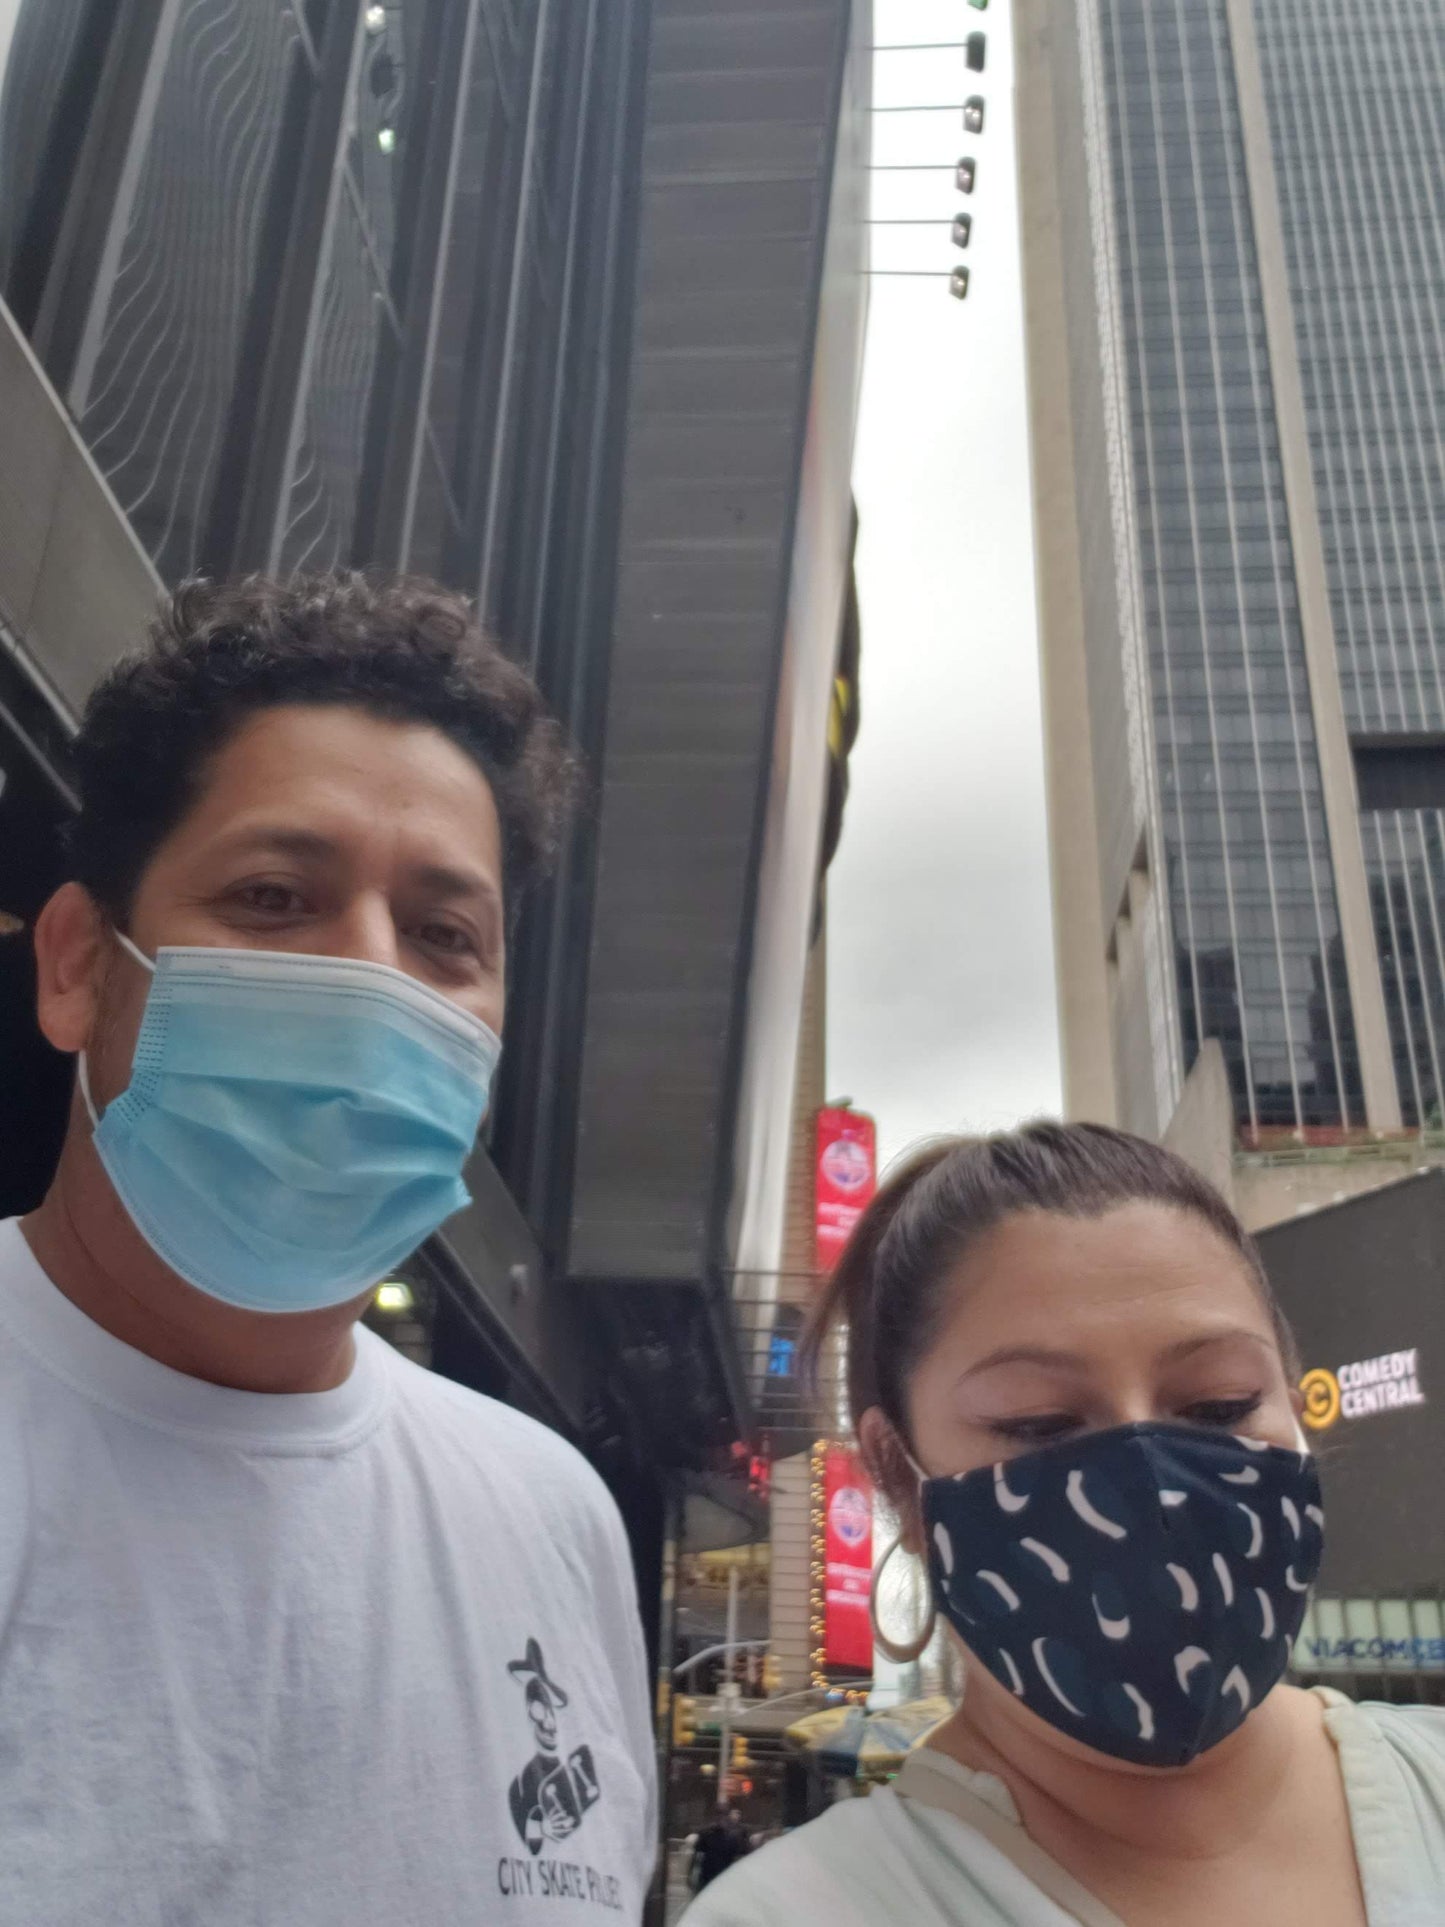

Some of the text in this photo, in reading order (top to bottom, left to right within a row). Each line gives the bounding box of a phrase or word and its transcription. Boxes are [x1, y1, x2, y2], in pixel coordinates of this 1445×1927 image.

[1337, 1347, 1418, 1391] COMEDY
[1341, 1375, 1425, 1419] CENTRAL
[498, 1857, 533, 1896] CITY
[538, 1859, 586, 1899] SKATE
